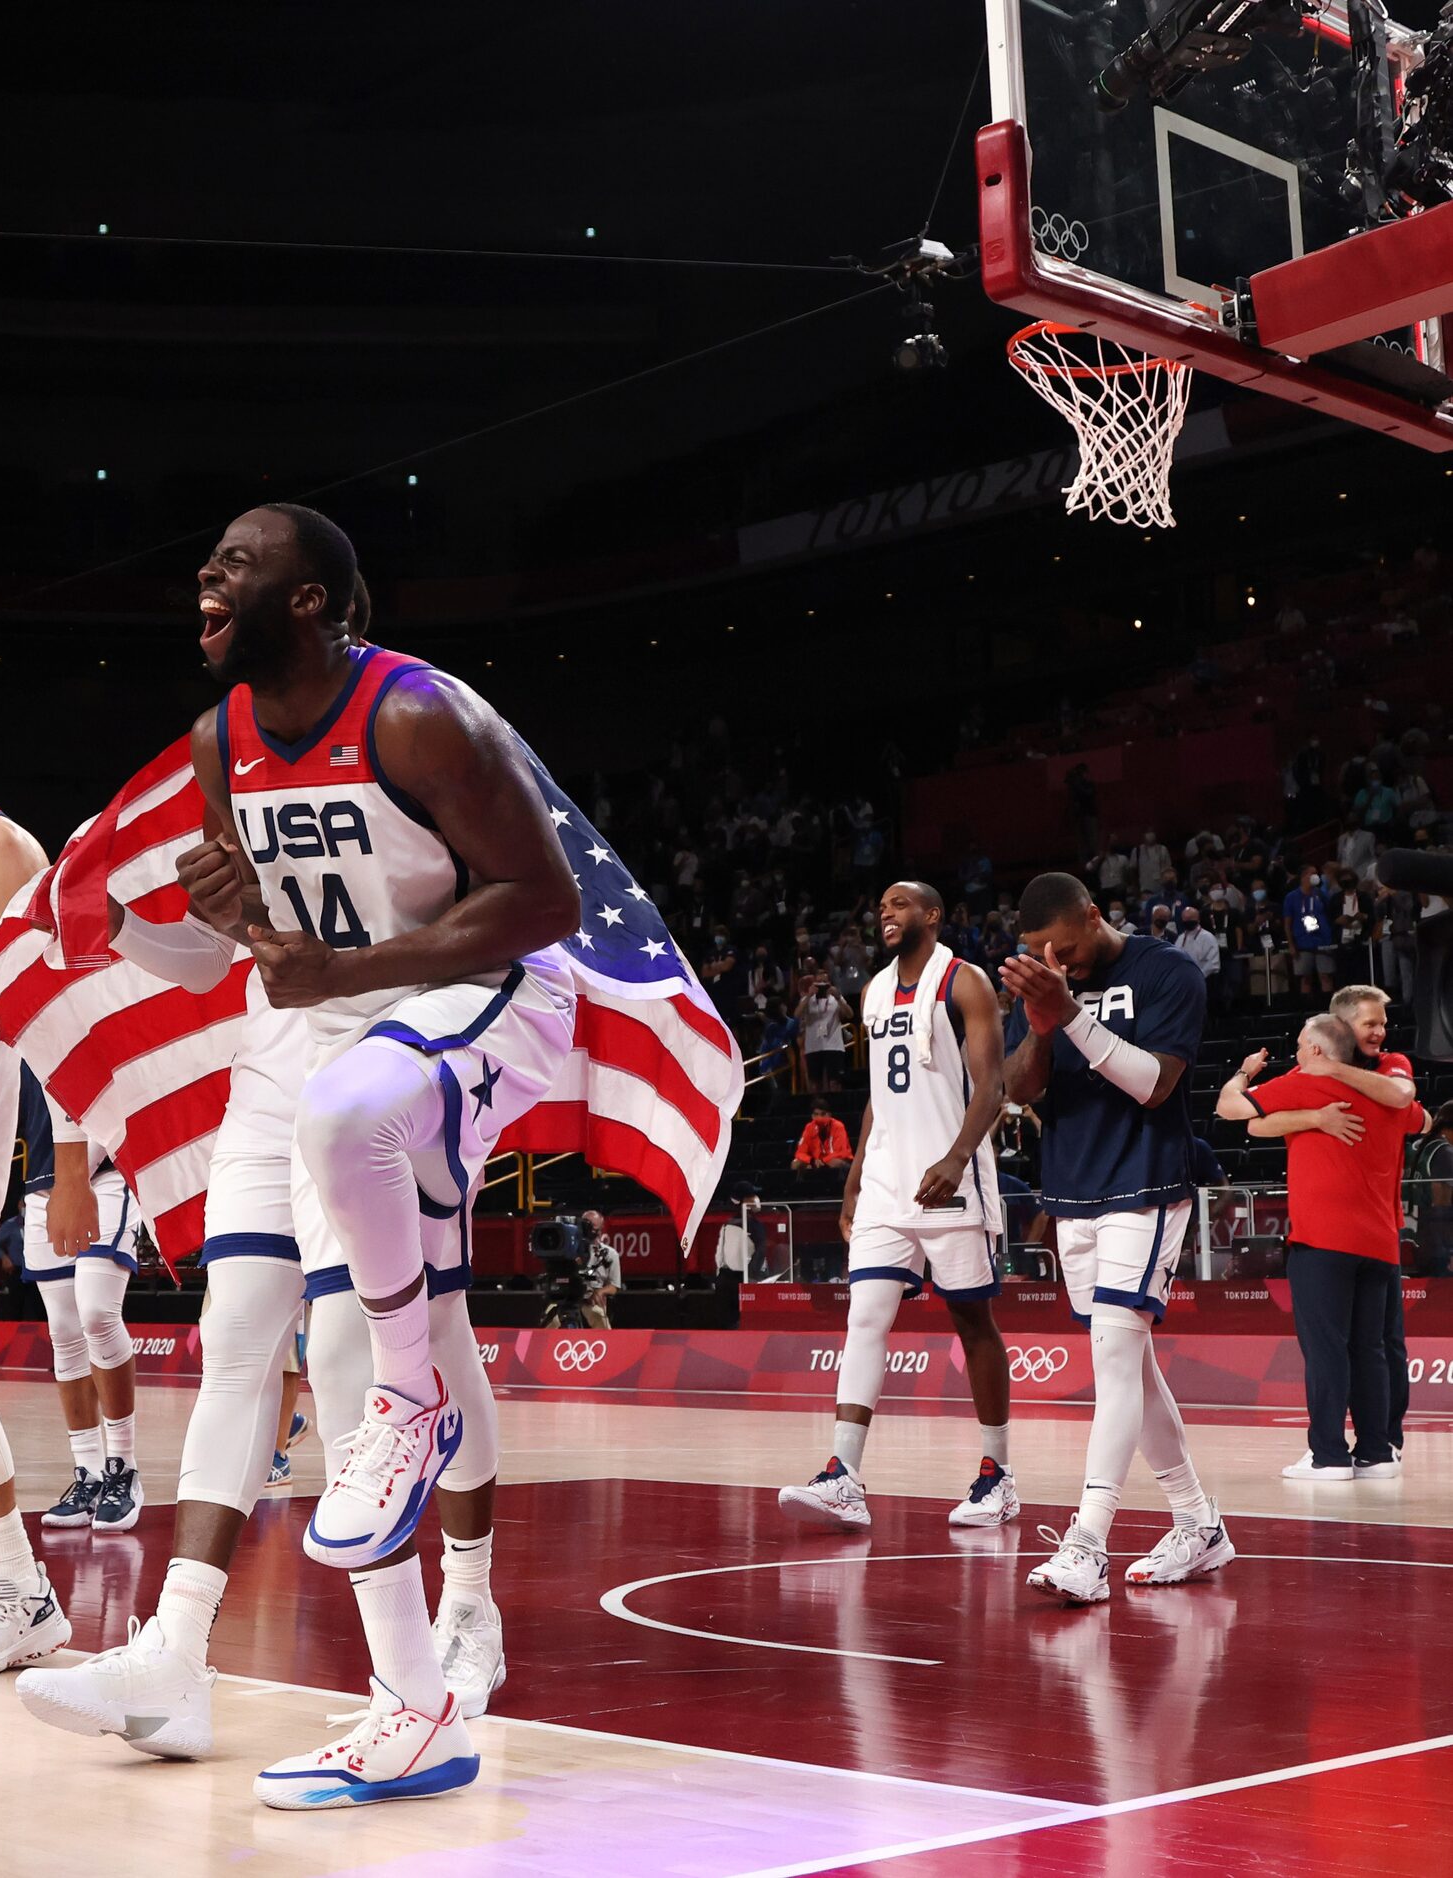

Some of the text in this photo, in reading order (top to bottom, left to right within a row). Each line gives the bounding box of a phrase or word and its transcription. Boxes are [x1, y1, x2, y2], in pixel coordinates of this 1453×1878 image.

[807, 447, 1068, 549] TOKYO 20
[239, 800, 373, 864] USA
[280, 873, 372, 951] 14
[1069, 984, 1135, 1021] SA
[871, 1011, 914, 1039] US
[888, 1044, 910, 1094] 8
[777, 1293, 812, 1301] TOKYO 2020
[1018, 1292, 1057, 1301] TOKYO 2020
[1177, 1291, 1195, 1300] 2020
[1224, 1290, 1269, 1300] TOKYO 2020
[1406, 1290, 1426, 1299] 2020
[142, 1338, 176, 1355] 2020
